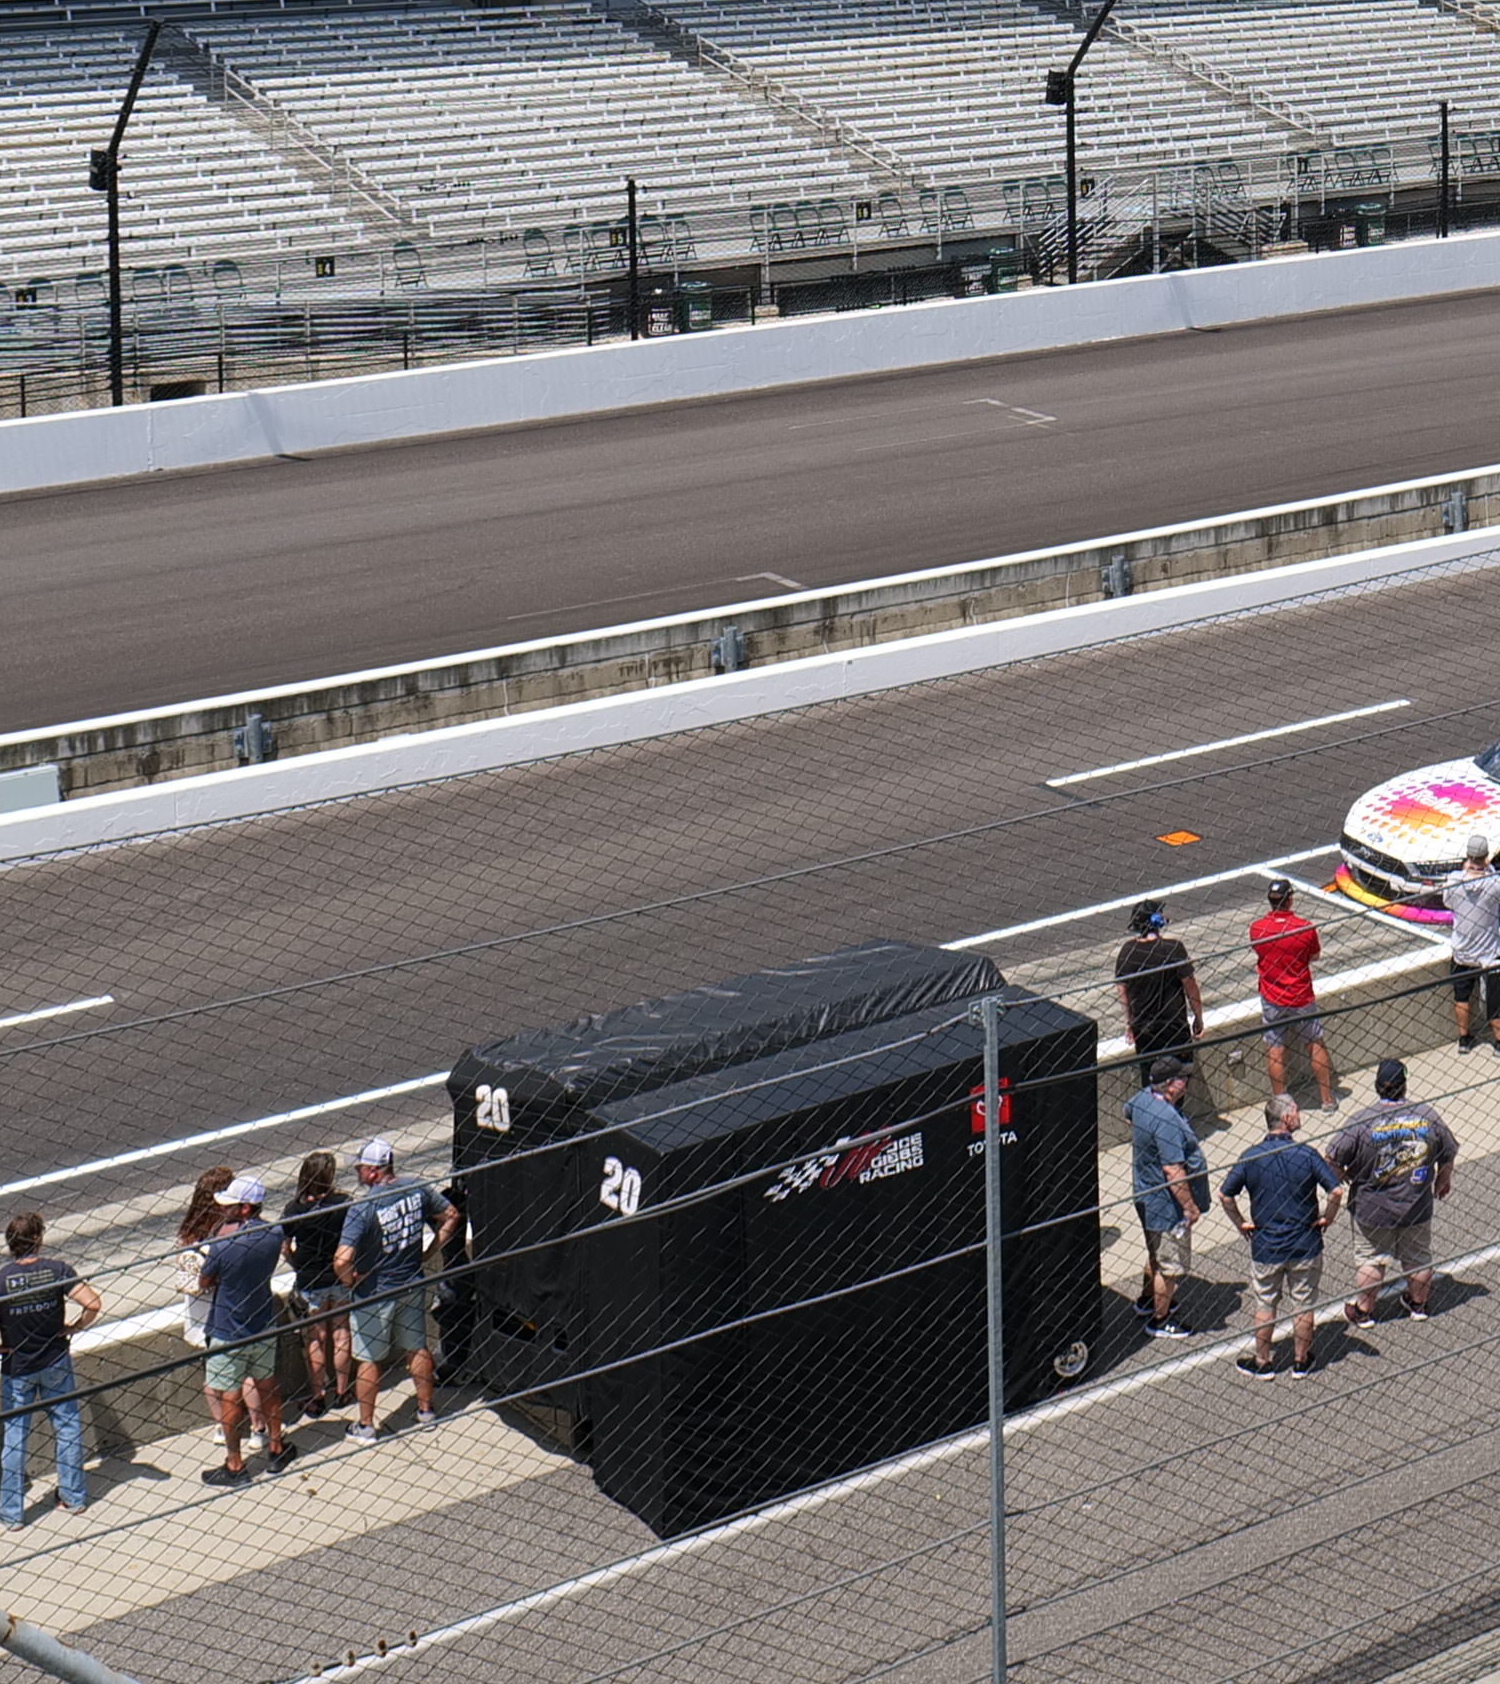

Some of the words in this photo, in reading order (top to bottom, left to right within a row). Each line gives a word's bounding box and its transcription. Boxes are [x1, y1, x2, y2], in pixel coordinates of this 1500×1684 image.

[475, 1084, 510, 1132] 20
[966, 1131, 1018, 1157] TOTA
[600, 1156, 642, 1216] 20
[859, 1157, 924, 1185] RACING
